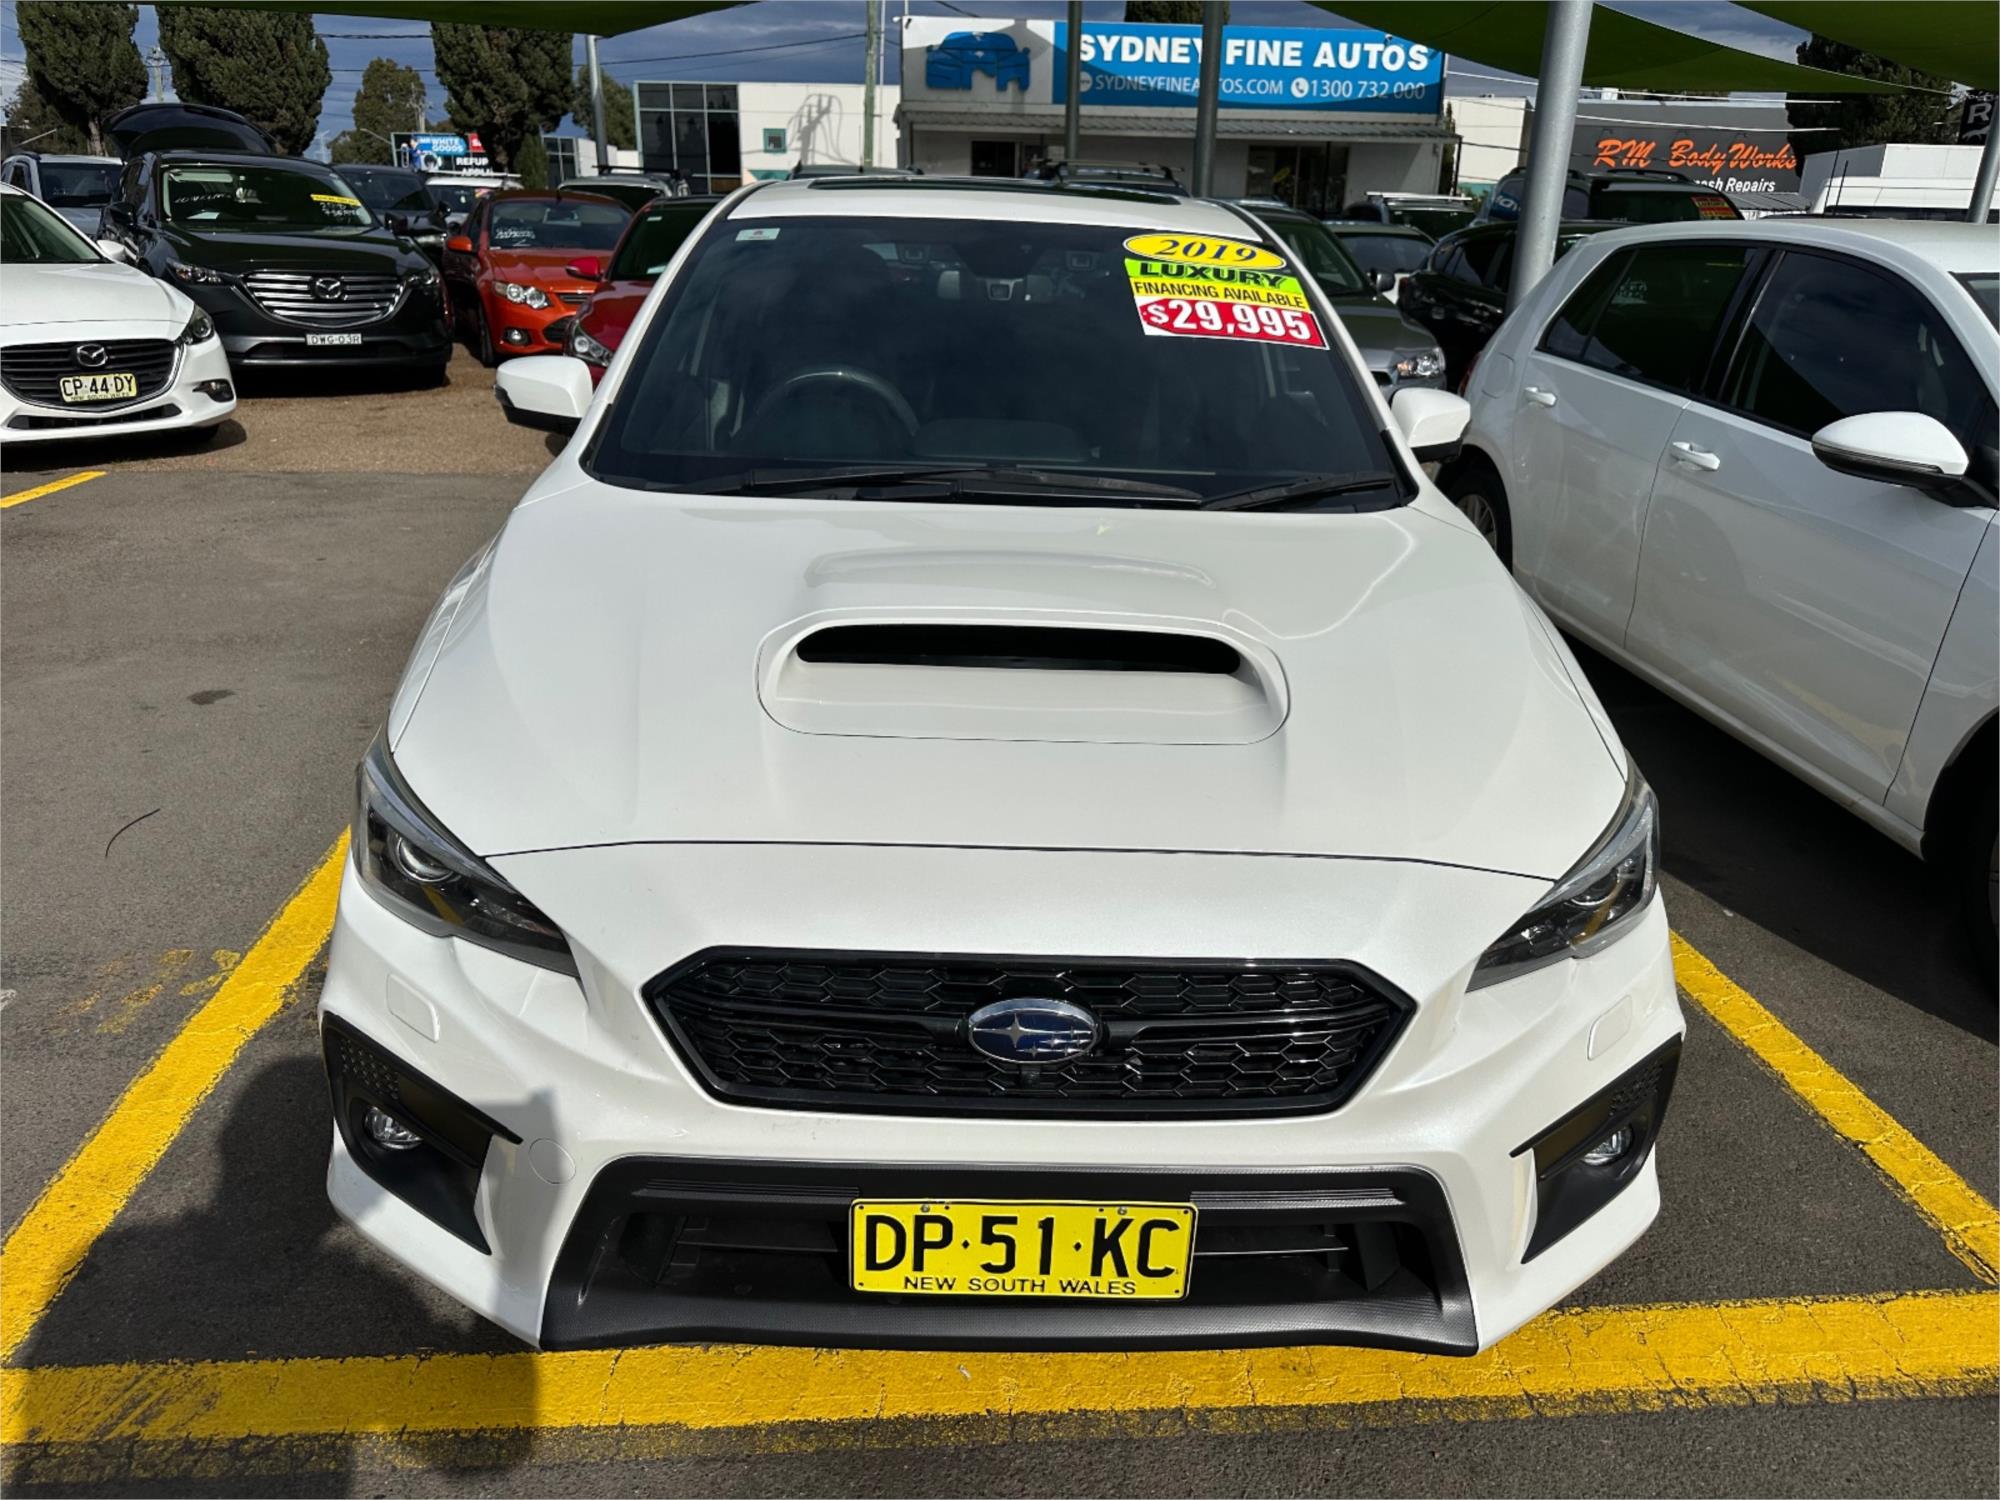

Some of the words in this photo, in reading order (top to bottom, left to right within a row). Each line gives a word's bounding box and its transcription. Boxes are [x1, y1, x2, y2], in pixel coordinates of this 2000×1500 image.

[1225, 39, 1303, 67] FINE
[1313, 42, 1428, 72] AUTOS
[1096, 74, 1283, 95] SYDNEYFINEAOS.COM
[1311, 80, 1352, 97] 1300
[1357, 81, 1388, 98] 732
[1394, 81, 1426, 99] 000
[1594, 139, 1656, 168] RM
[1668, 139, 1727, 175] Body
[1728, 143, 1798, 170] Works
[1726, 177, 1776, 193] Repairs
[1155, 239, 1257, 263] 2019
[1140, 262, 1285, 288] LUXURY
[1134, 281, 1219, 298] FINANCING
[1223, 286, 1307, 309] AVAILABLE
[1146, 299, 1311, 340] $29,995
[904, 1276, 957, 1290] NEW
[968, 1278, 1046, 1293] SOUTH
[1059, 1279, 1137, 1295] WALES
